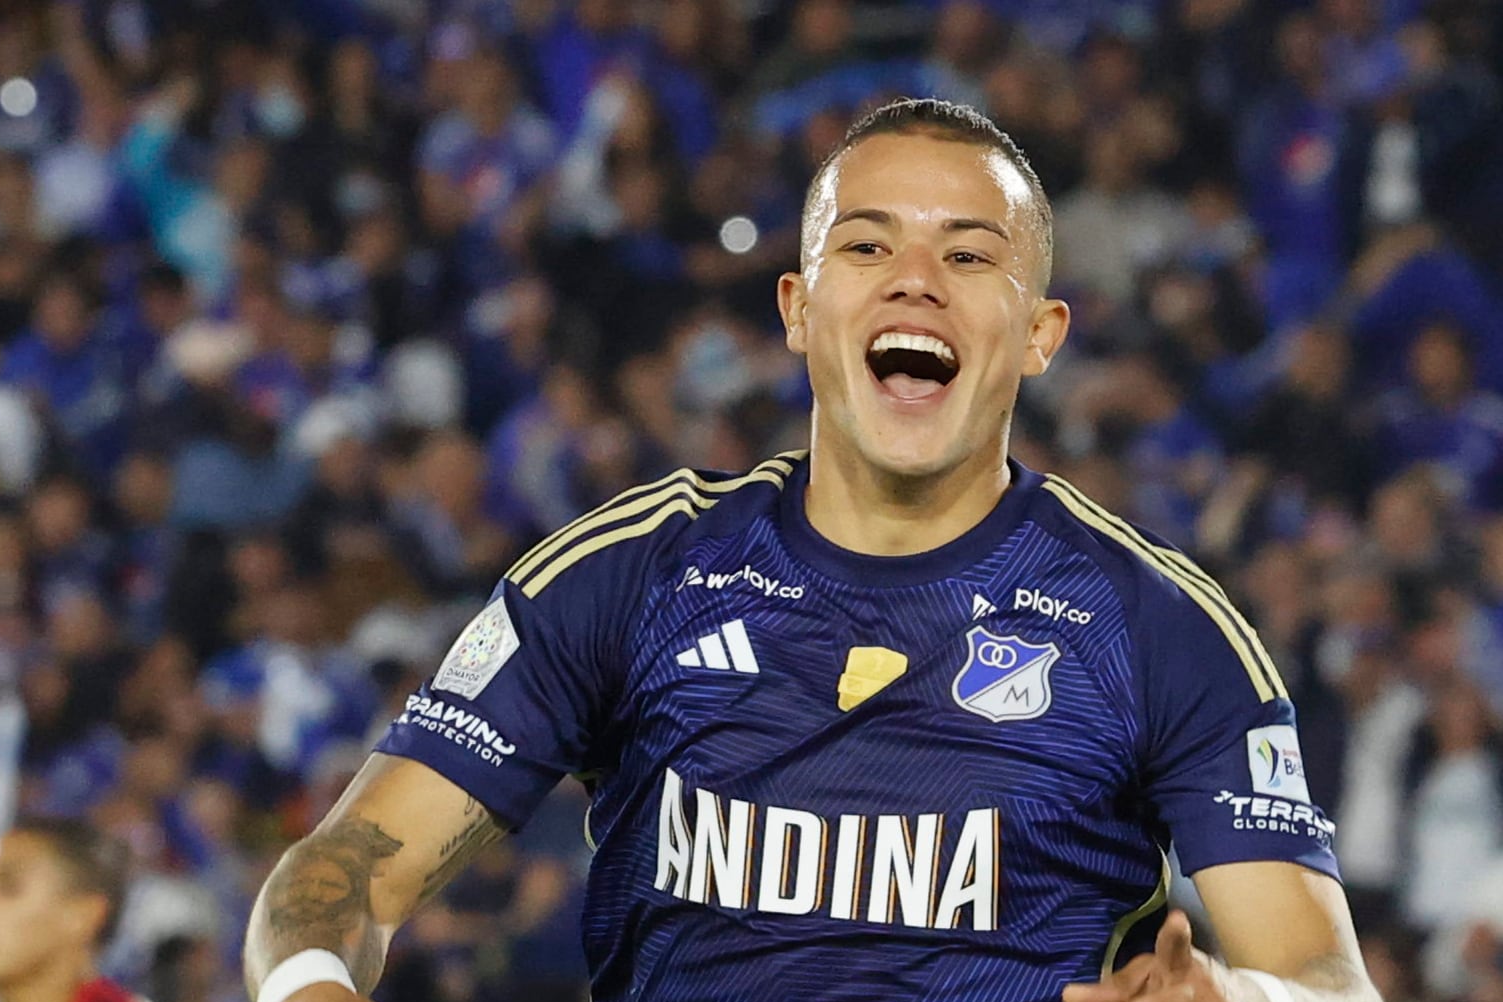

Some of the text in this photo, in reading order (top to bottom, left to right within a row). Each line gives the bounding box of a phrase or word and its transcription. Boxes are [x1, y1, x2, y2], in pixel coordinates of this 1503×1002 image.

[411, 715, 504, 767] PROTECTION
[653, 767, 1000, 931] ANDINA
[1233, 818, 1299, 835] GLOBAL
